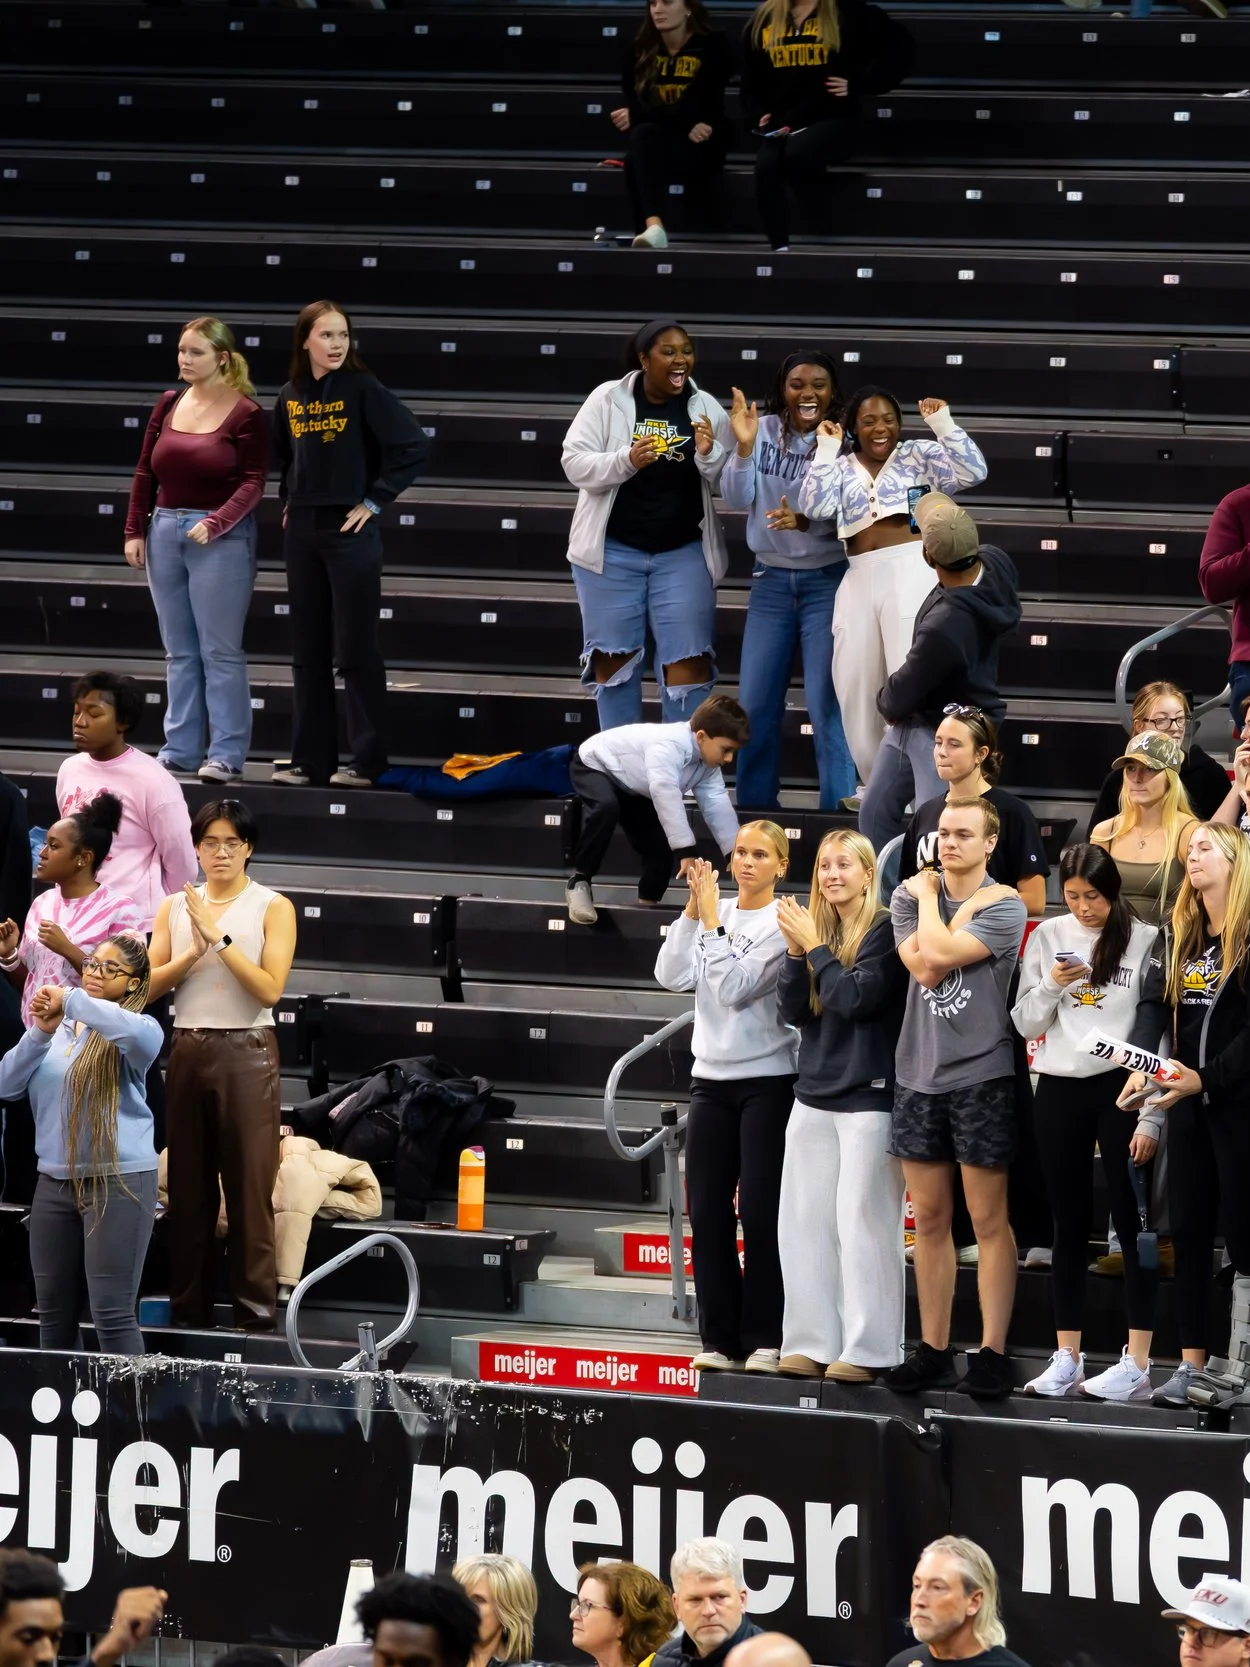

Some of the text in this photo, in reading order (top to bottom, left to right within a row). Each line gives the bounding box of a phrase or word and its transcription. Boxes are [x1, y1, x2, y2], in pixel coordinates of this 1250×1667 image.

[494, 1351, 701, 1392] meijer meijer meij
[406, 1437, 858, 1618] meijer
